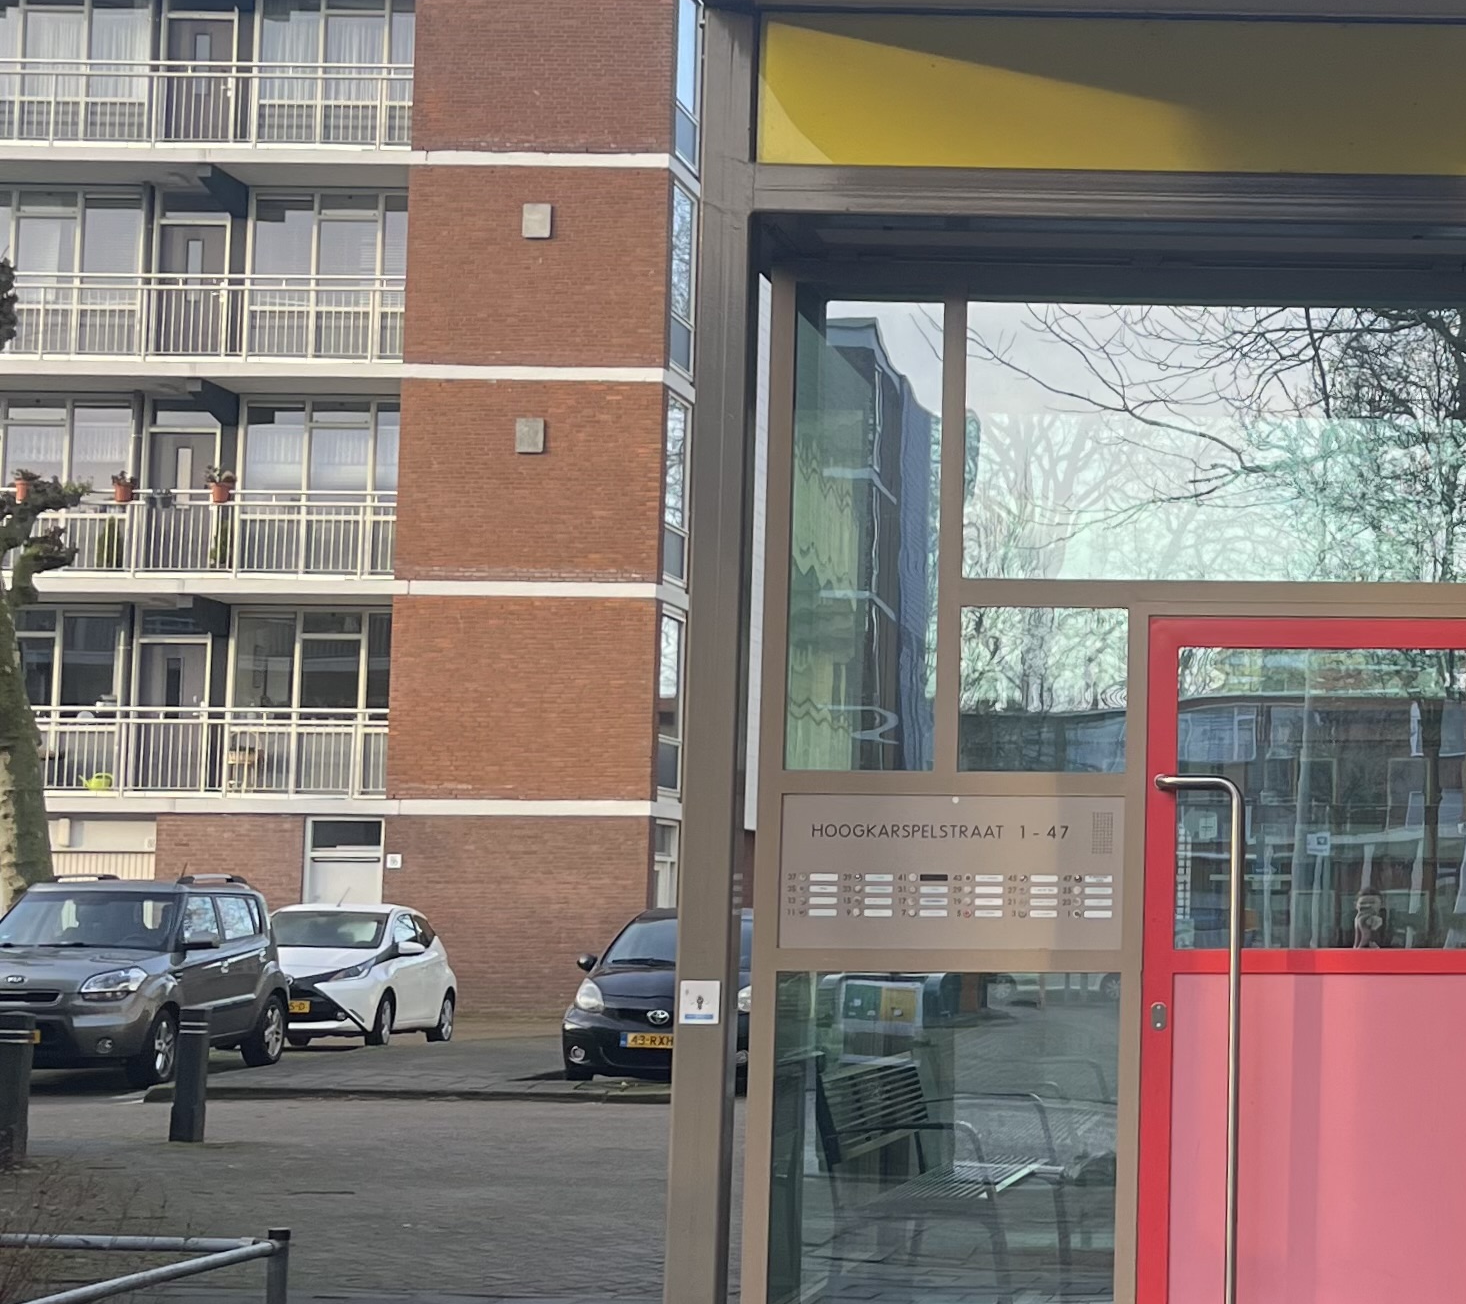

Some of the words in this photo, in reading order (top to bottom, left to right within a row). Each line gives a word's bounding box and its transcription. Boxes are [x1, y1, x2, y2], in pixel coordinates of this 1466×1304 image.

[811, 824, 1003, 839] HOOGKARSPELSTRAAT
[1020, 826, 1025, 839] 1
[1047, 826, 1069, 839] 47
